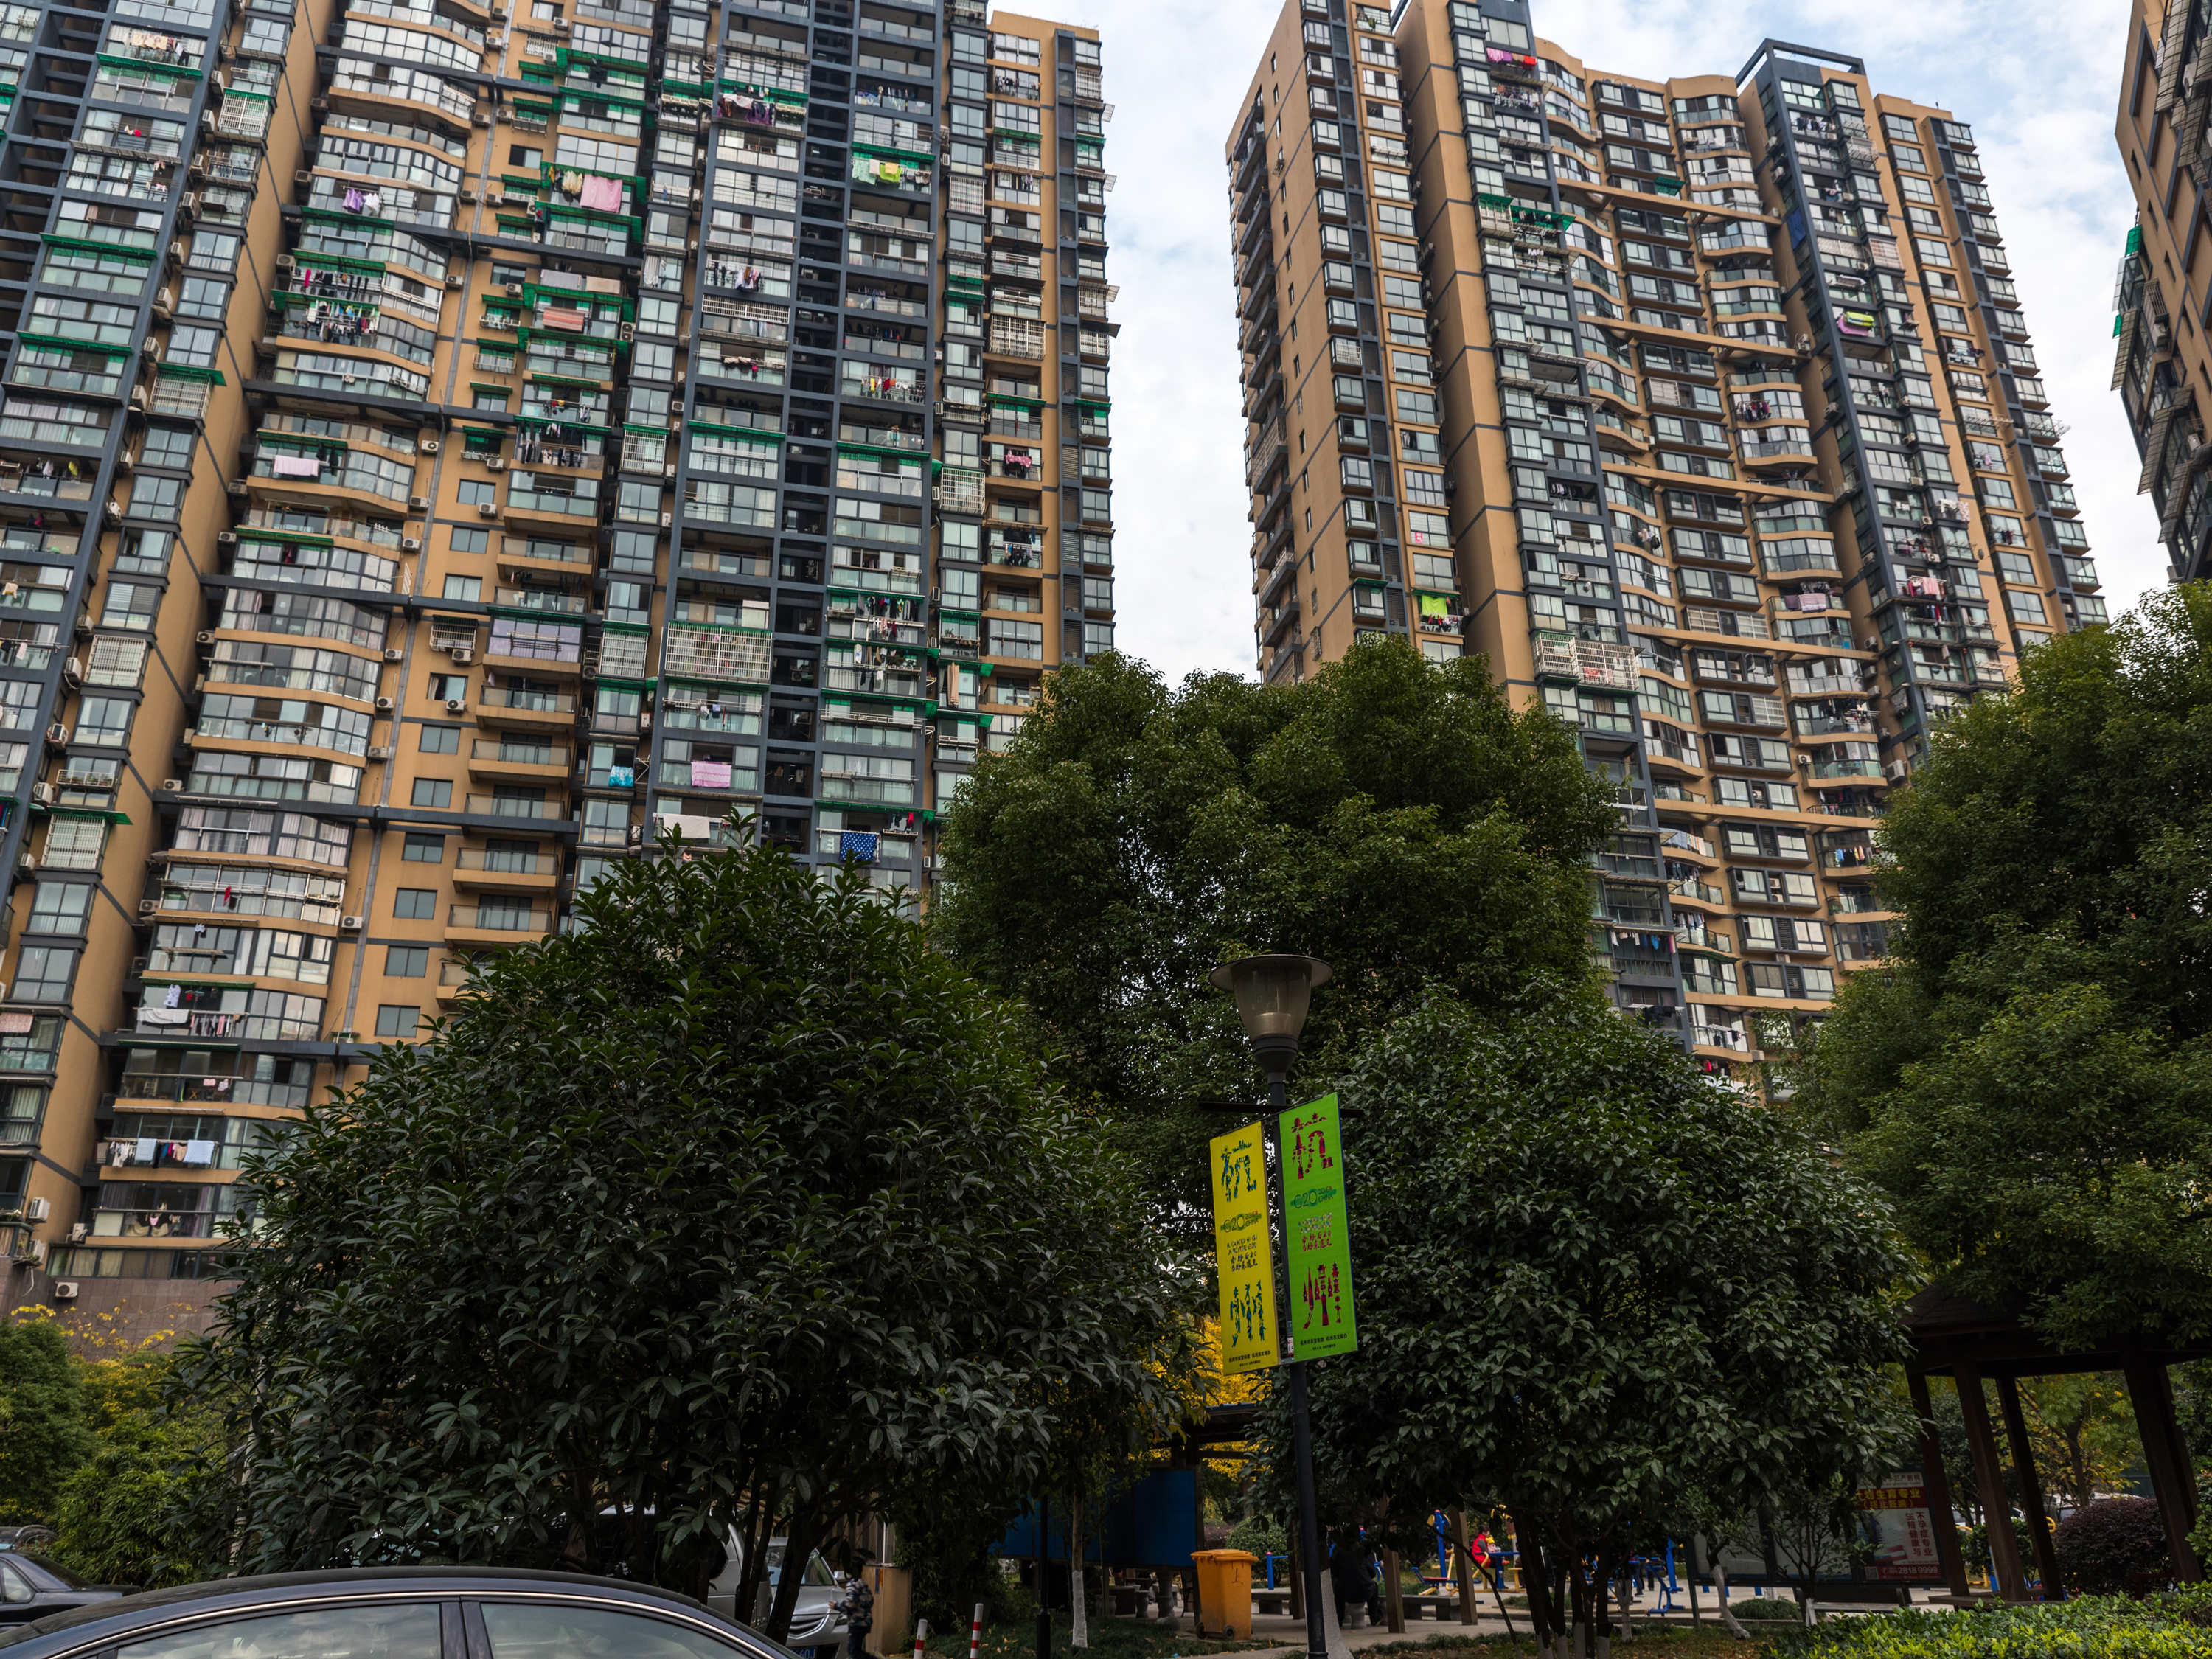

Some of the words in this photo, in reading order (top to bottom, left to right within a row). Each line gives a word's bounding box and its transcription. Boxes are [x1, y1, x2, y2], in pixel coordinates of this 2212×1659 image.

[1291, 1111, 1334, 1180] 杭
[1318, 1186, 1329, 1194] 2016
[1294, 1190, 1317, 1208] G20
[1318, 1194, 1333, 1203] CHINA
[1245, 1211, 1256, 1220] 2016
[1245, 1218, 1259, 1226] CHINA
[1224, 1215, 1245, 1233] G20
[1905, 1512, 1921, 1557] 生殖健康与
[1916, 1512, 1933, 1556] 不孕症专业
[1898, 1566, 1917, 1574] 2818
